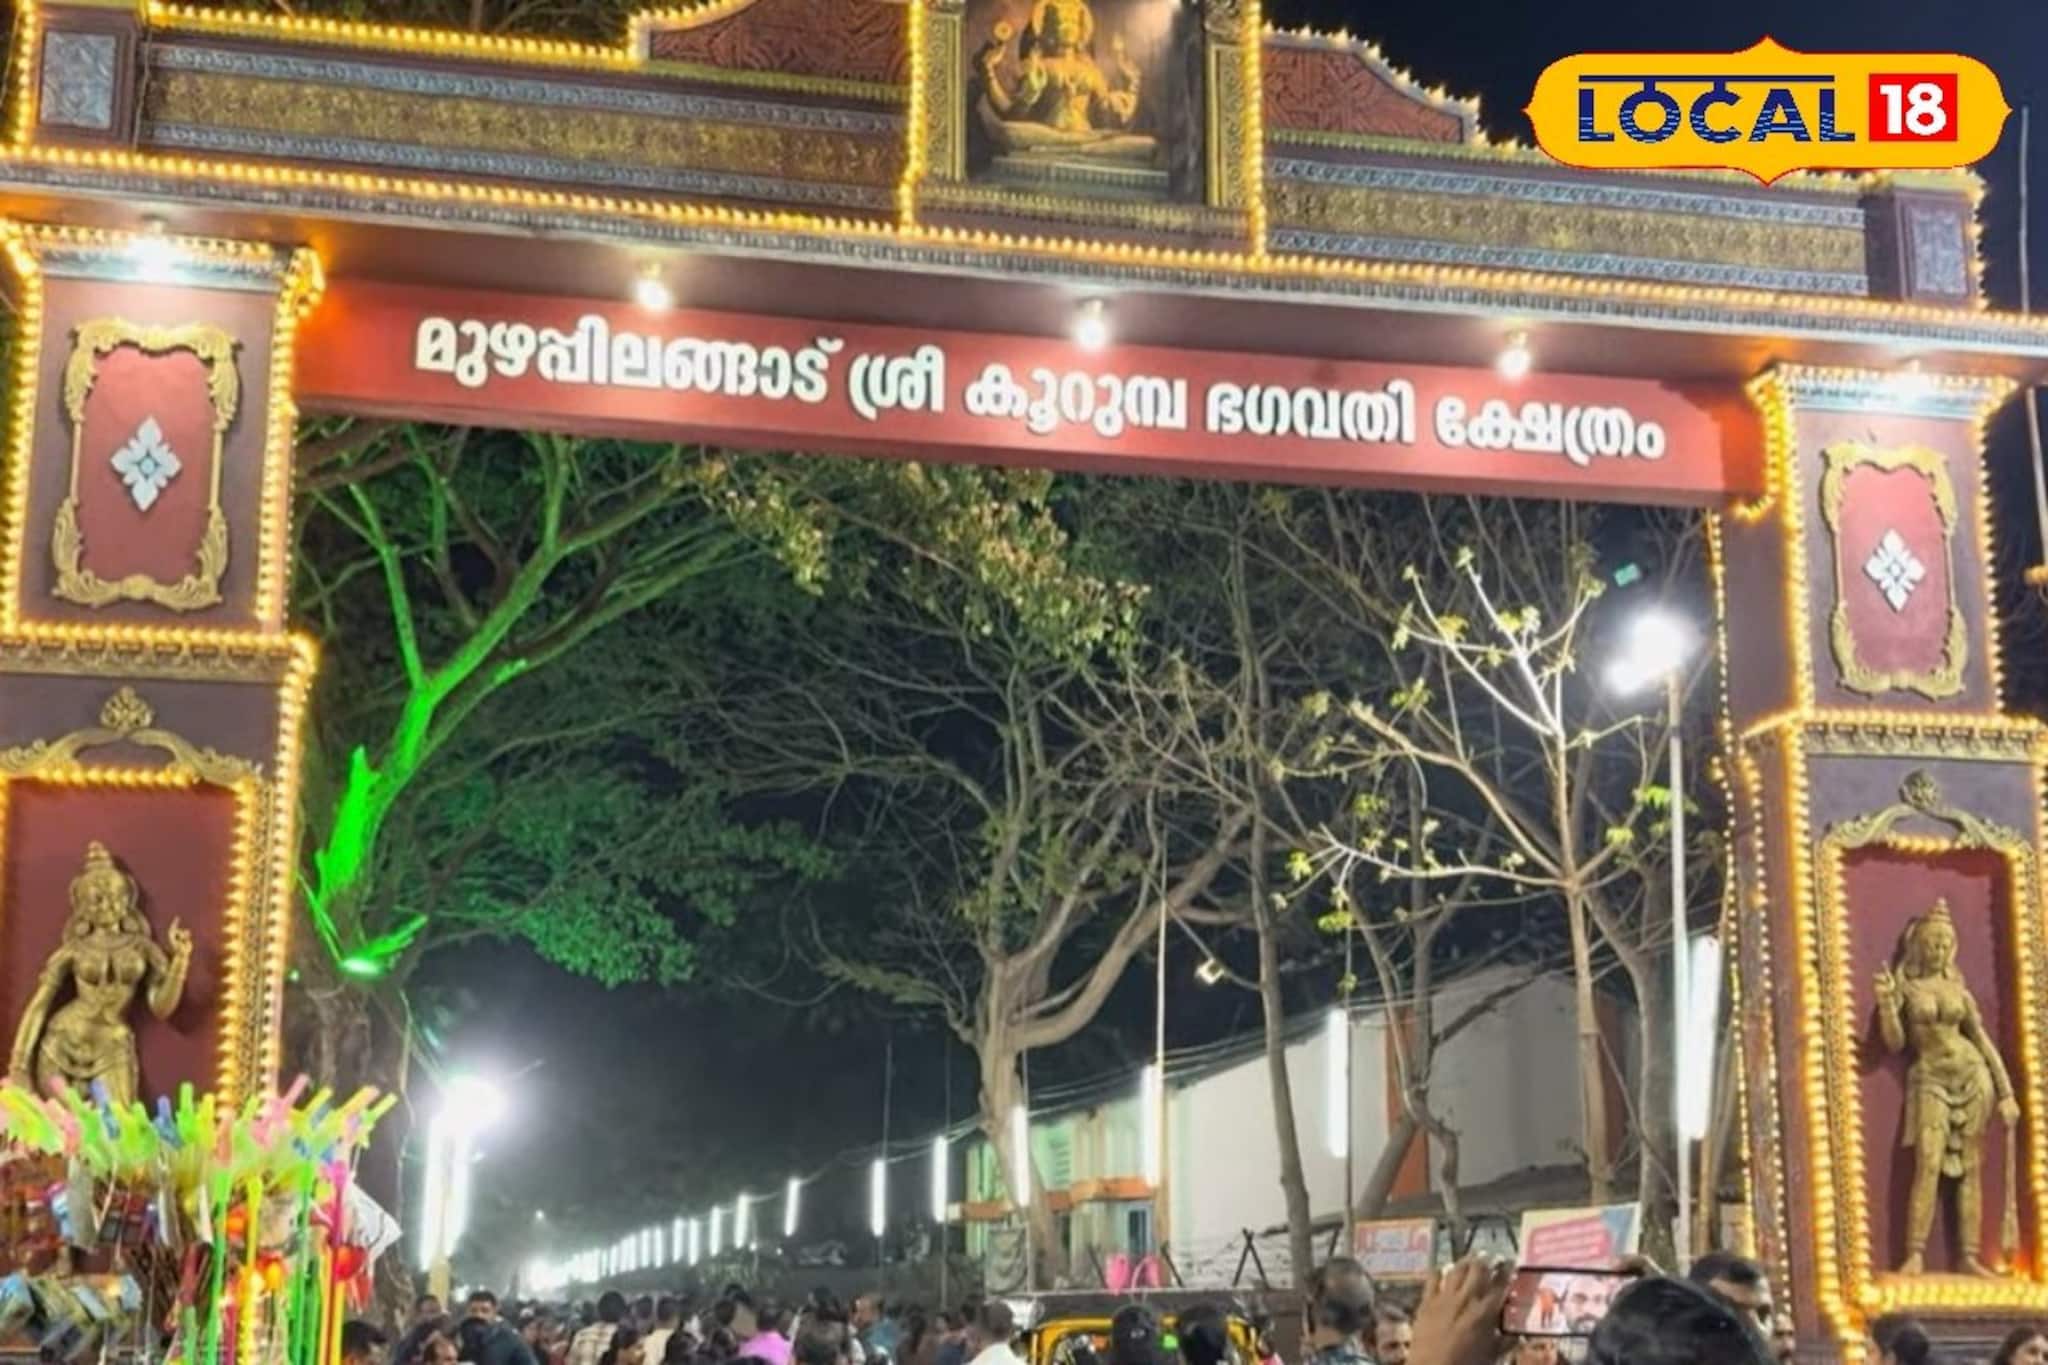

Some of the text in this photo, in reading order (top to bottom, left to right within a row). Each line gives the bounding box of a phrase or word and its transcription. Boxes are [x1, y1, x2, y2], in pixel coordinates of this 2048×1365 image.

[415, 313, 843, 403] മുഴപ്പിലങ്ങാട്
[849, 345, 944, 421] ശ്രീ
[1206, 378, 1417, 443] ഭഗവതി
[1435, 395, 1666, 466] ക്ഷേത്രം
